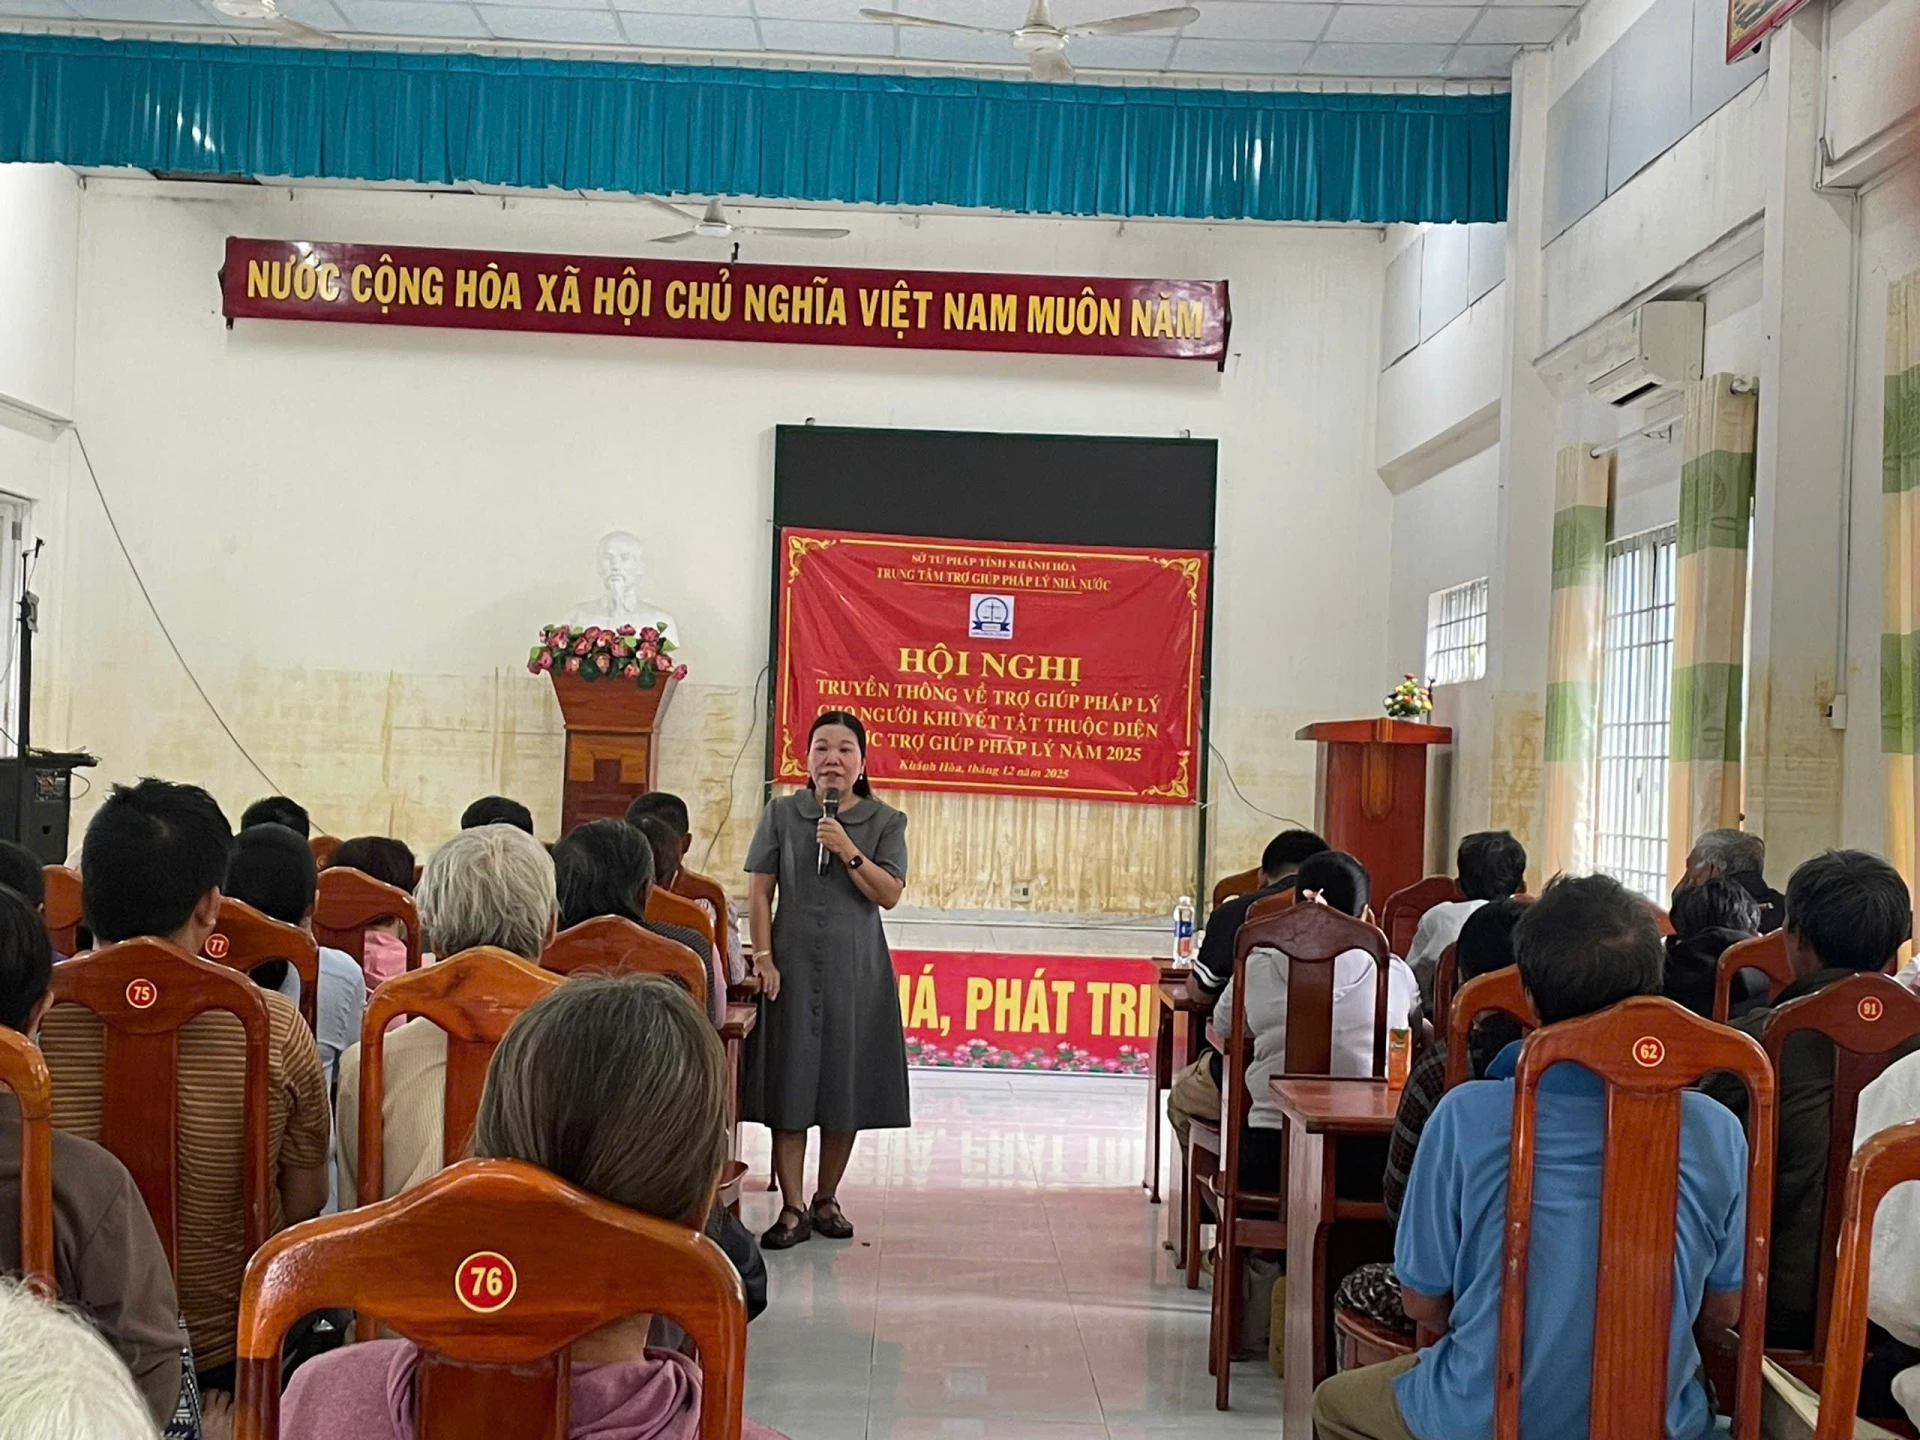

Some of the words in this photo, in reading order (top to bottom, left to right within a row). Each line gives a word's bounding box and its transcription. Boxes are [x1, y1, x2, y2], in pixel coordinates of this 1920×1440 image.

[247, 252, 341, 302] NƯỚC
[351, 253, 444, 314] CỘNG
[535, 265, 581, 313] XÃ
[593, 266, 651, 326] HỘI
[665, 268, 732, 322] CHỦ
[744, 276, 847, 326] NGHĨA
[859, 279, 933, 339] VIỆT
[943, 292, 1018, 332] NAM
[1027, 286, 1121, 336] MUÔN
[1130, 291, 1203, 339] NĂM
[946, 555, 977, 566] PHÁP
[1008, 558, 1050, 571] KHÁNH
[1052, 560, 1076, 572] HÒA
[876, 567, 915, 580] TRUNG
[918, 568, 944, 582] TÂM
[946, 571, 970, 584] TRỢ
[971, 571, 1000, 585] GIÚP
[1002, 572, 1033, 587] PHÁP
[1034, 573, 1050, 588] LÝ
[1052, 576, 1076, 589] NHÀ
[1080, 576, 1112, 591] NƯỚC
[897, 642, 971, 680] HỘI
[981, 652, 1082, 687] NGHỊ
[816, 675, 889, 697] TRUYỀN
[894, 681, 958, 703] THÔNG
[963, 682, 988, 704] VỀ
[993, 689, 1031, 709] TRỢ
[1034, 690, 1080, 709] GIÚP
[1084, 692, 1133, 712] PHÁP
[1137, 694, 1161, 714] LÝ
[860, 705, 917, 725] NGƯỜI
[923, 707, 999, 730] KHUYẾT
[1003, 712, 1041, 734] TẬT
[1045, 716, 1109, 737] THUỘC
[1113, 718, 1158, 740] DIỆN
[887, 733, 925, 753] TRỢ
[929, 733, 974, 752] GIÚP
[978, 736, 1027, 756] PHÁP
[1031, 738, 1055, 758] LÝ
[1059, 740, 1102, 760] NĂM
[1106, 746, 1142, 762] 2025
[899, 759, 936, 771] Khánh
[967, 763, 1000, 776] tháng
[1016, 767, 1042, 777] năm
[1043, 767, 1070, 779] 2025
[212, 940, 224, 952] 77
[133, 986, 150, 1001] 75
[965, 967, 1075, 1034] PHÁT
[1863, 1002, 1877, 1015] 91
[1640, 1044, 1658, 1059] 62
[470, 1267, 503, 1296] 76
